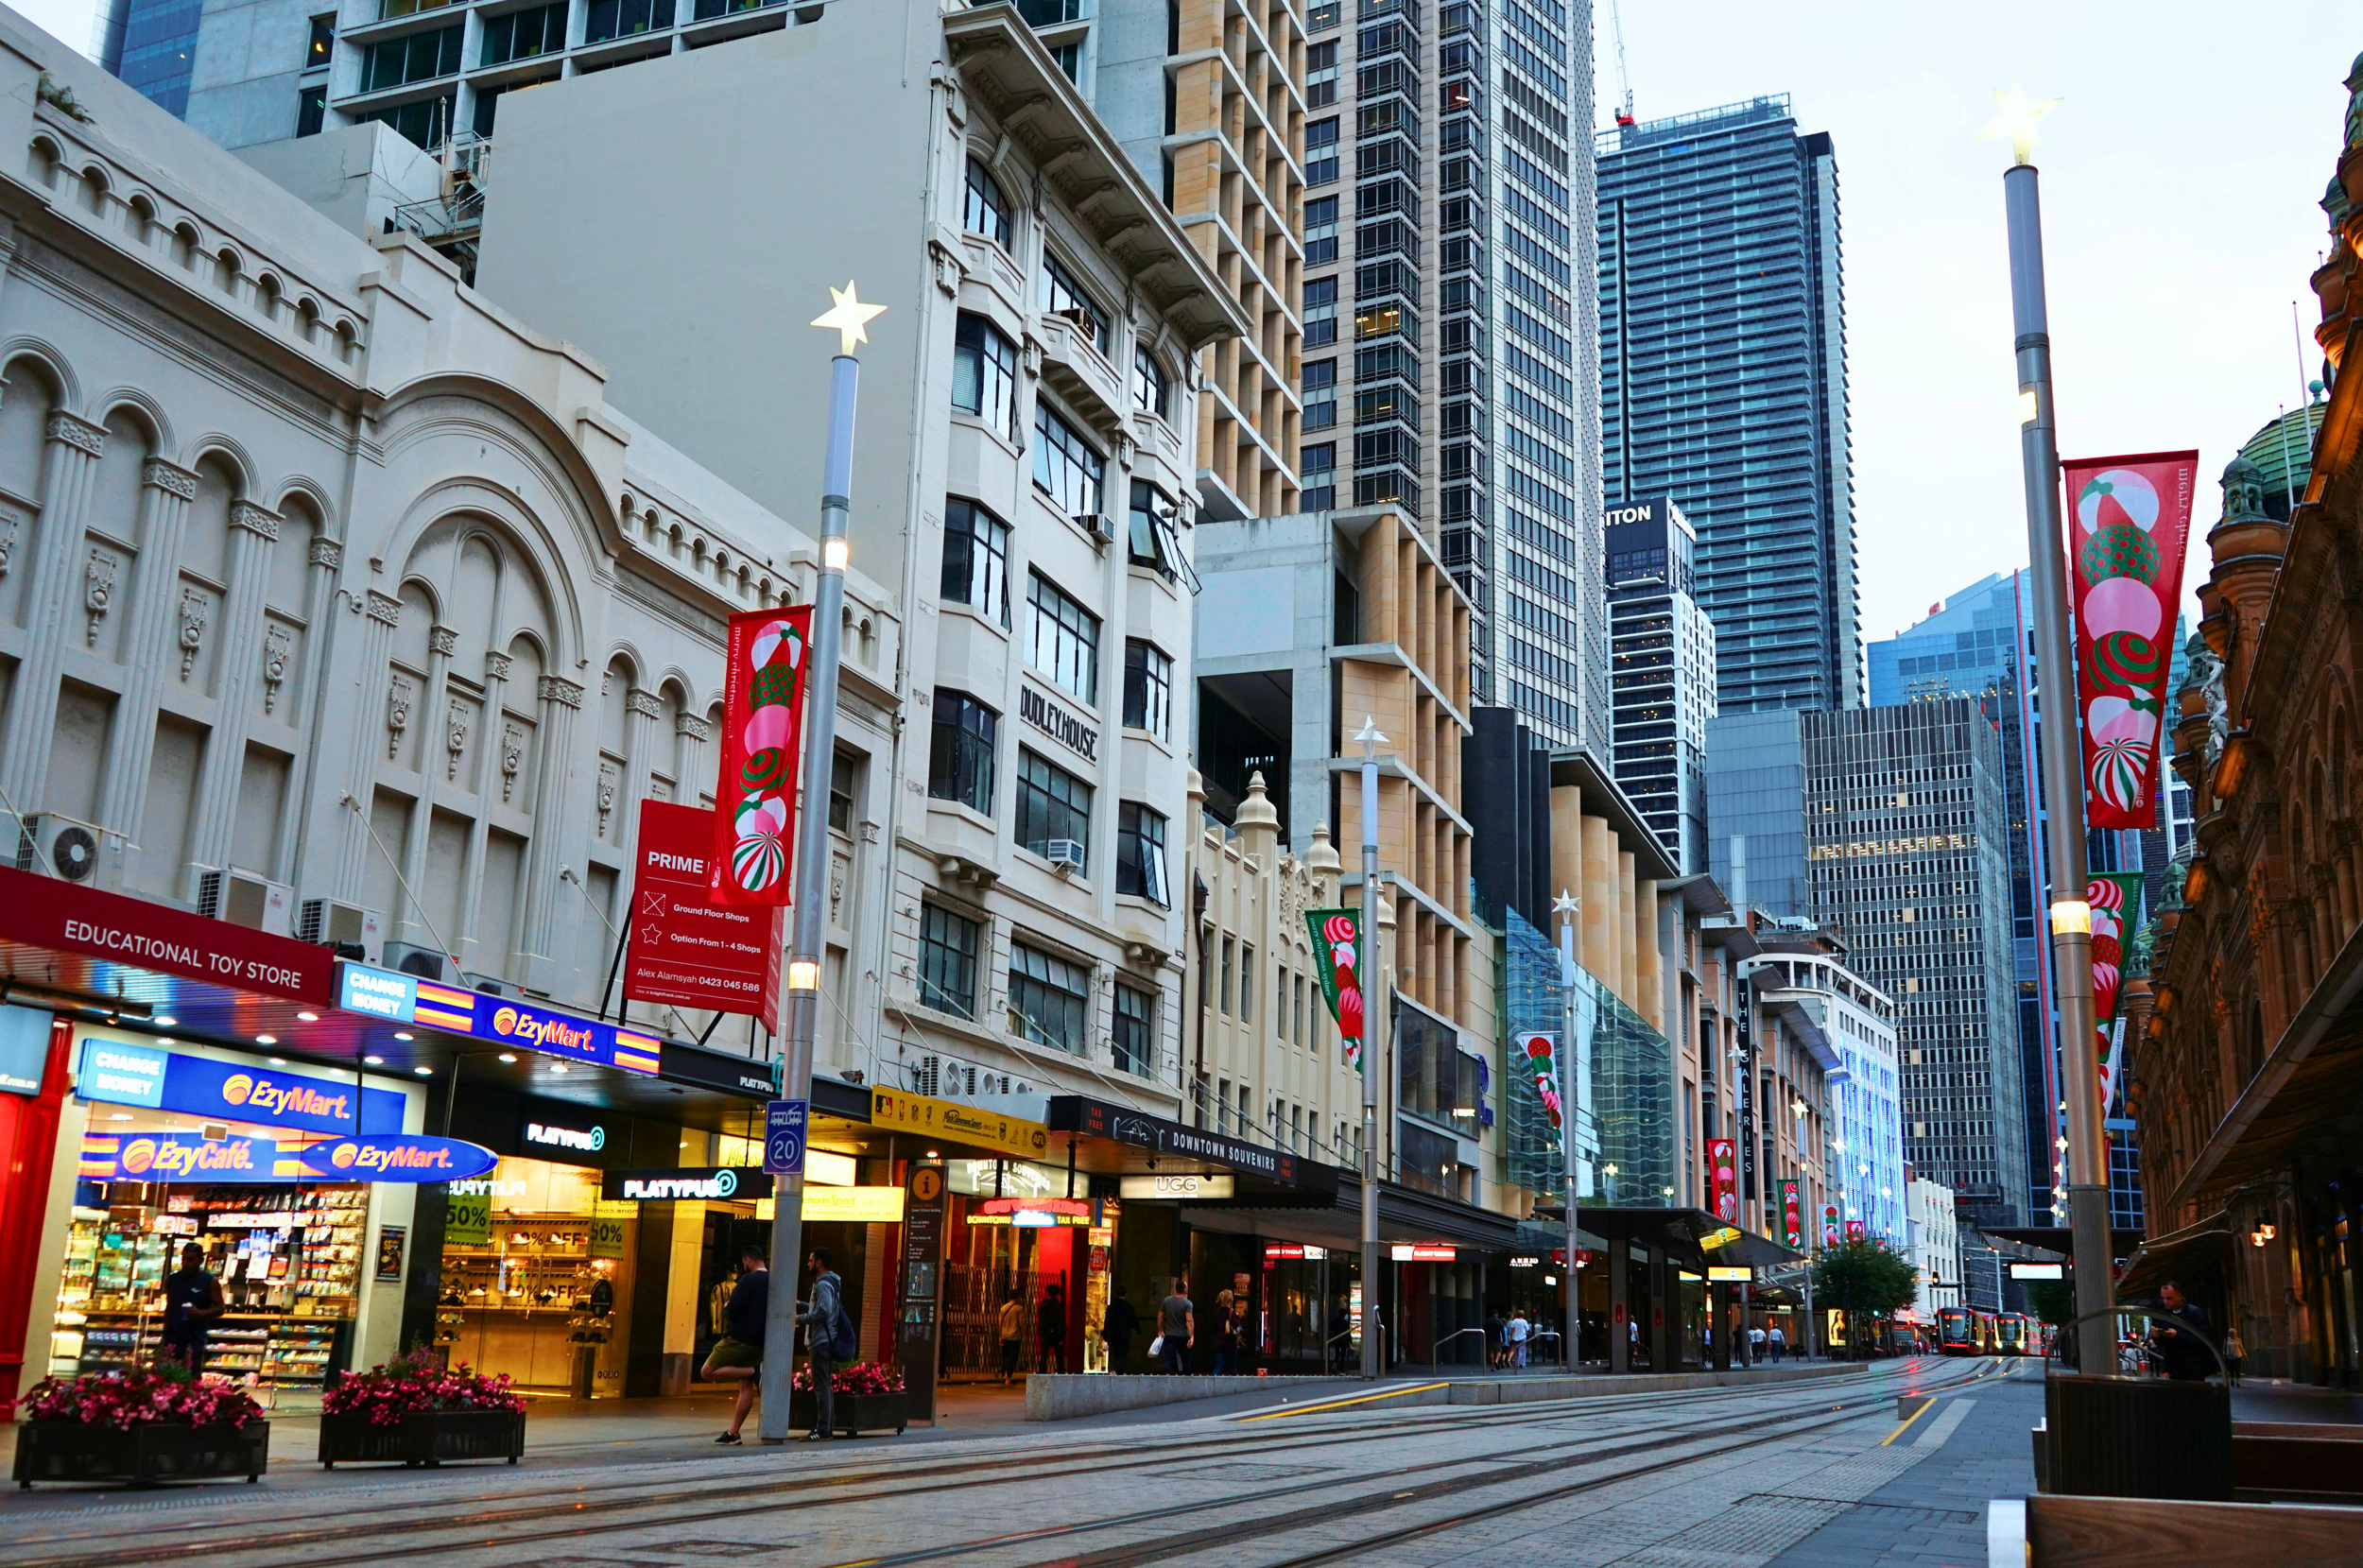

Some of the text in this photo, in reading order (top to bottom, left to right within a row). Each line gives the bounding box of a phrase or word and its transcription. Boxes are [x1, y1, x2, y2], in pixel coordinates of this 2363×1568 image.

[1606, 505, 1651, 526] ITON
[733, 627, 741, 660] merry
[647, 851, 704, 874] PRIME
[673, 904, 750, 923] Ground Floor Shops
[64, 919, 302, 990] EDUCATIONAL TOY STORE
[670, 933, 698, 946] Option
[699, 937, 719, 948] From
[720, 939, 725, 948] 1
[730, 941, 736, 950] 4
[736, 943, 761, 955] Shops
[1310, 918, 1332, 997] merry christmas sydney
[349, 972, 407, 1000] CHANGE
[637, 967, 760, 993] Alex Alamsyah 0423 045 586
[351, 991, 403, 1016] MONEY
[514, 1012, 594, 1052] EzyMart
[95, 1051, 162, 1077] CHANGE
[95, 1073, 154, 1096] MONEY
[739, 1076, 774, 1093] PLATYPUS
[1738, 992, 1752, 1173] THE GALERIES
[249, 1080, 348, 1119] EzyMart
[1091, 1107, 1102, 1119] TAX
[527, 1123, 594, 1150] PLATYPUS
[1088, 1119, 1104, 1131] FREE
[773, 1140, 795, 1160] 20
[1032, 1134, 1044, 1146] AFL
[1172, 1131, 1275, 1171] DOWNTOWN SOUVENIRS
[153, 1140, 251, 1176] EzyCafé
[354, 1146, 449, 1172] EzyMart
[967, 1159, 1009, 1174] DOWNTON
[1282, 1159, 1291, 1167] TAX
[624, 1180, 721, 1198] PLATYPUS
[1155, 1177, 1198, 1193] UGG
[831, 1194, 856, 1207] Sport
[445, 1204, 487, 1227] 50%
[967, 1215, 1011, 1225] DOWNTOWN
[1057, 1215, 1090, 1225] TAX FREE
